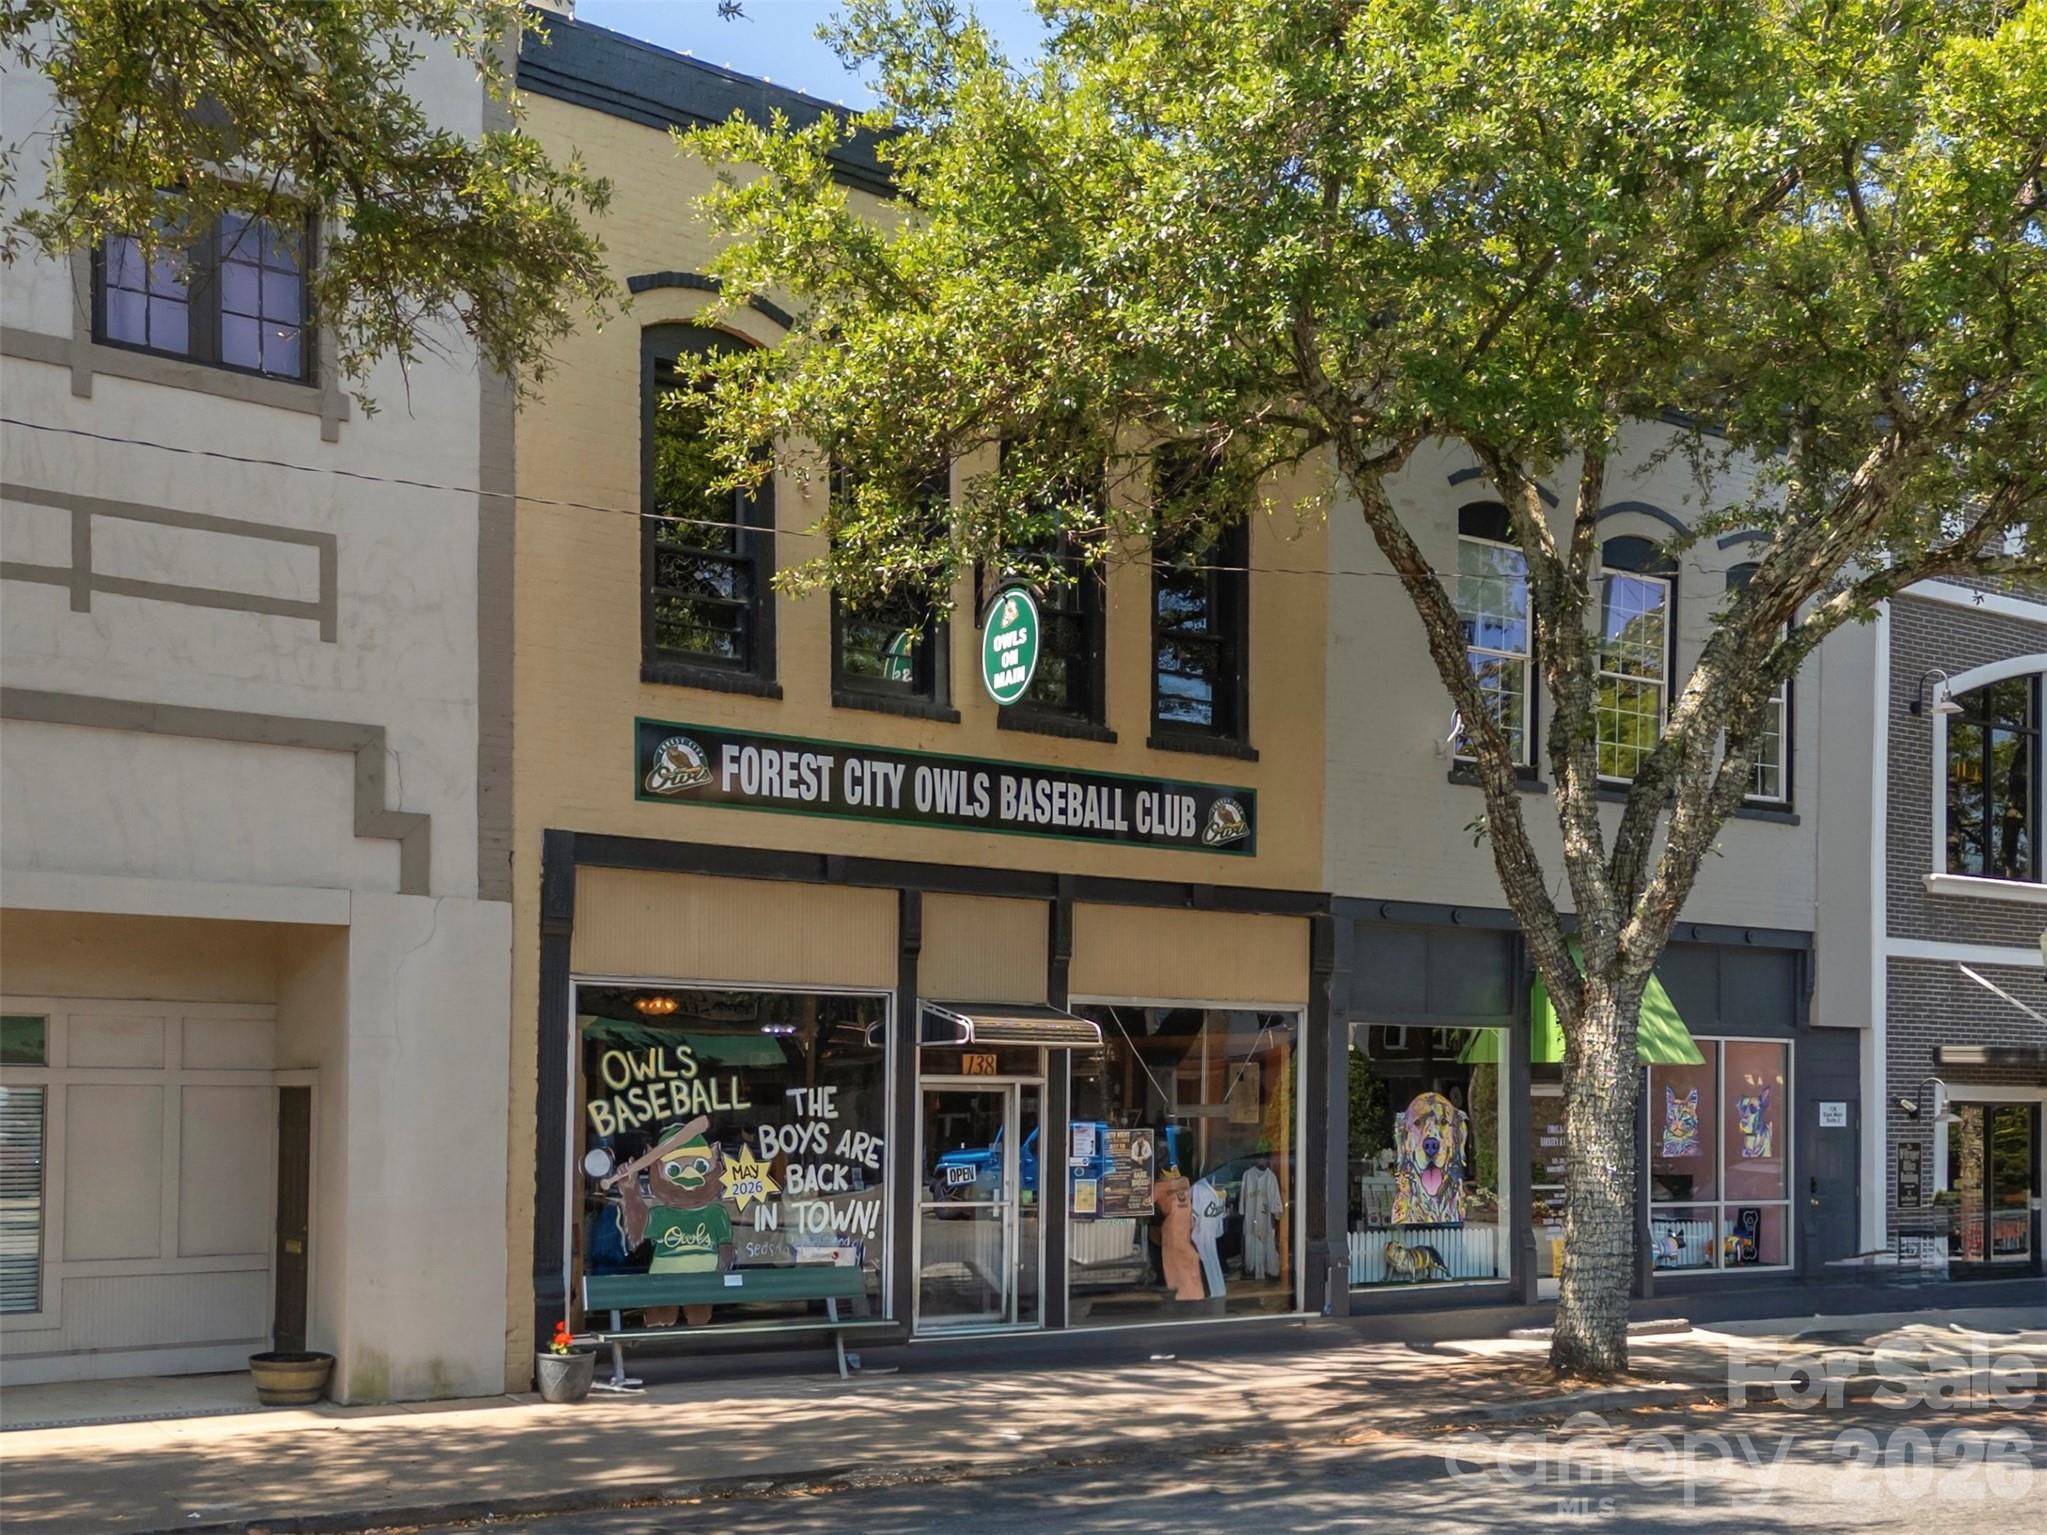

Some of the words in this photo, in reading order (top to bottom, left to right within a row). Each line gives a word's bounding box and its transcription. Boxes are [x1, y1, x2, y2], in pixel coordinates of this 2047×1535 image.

[993, 628, 1028, 653] OWLS
[1001, 648, 1019, 669] ON
[993, 665, 1026, 690] MAIN
[721, 743, 835, 803] FOREST
[843, 758, 906, 809] CITY
[914, 765, 991, 819] OWLS
[1000, 774, 1129, 832] BASEBALL
[1135, 790, 1197, 838] CLUB
[602, 1044, 698, 1091] OWLS
[968, 1055, 996, 1076] 138
[587, 1075, 752, 1138] BASEBALL
[785, 1085, 840, 1119] THE
[758, 1121, 831, 1161] BOYS
[834, 1129, 885, 1170] ARE
[732, 1164, 760, 1181] MAY
[785, 1163, 850, 1195] BACK
[948, 1166, 975, 1183] OPEN
[732, 1180, 764, 1196] 2026
[753, 1202, 778, 1233] IN
[791, 1199, 881, 1240] TOWN!
[664, 1222, 712, 1248] Owls
